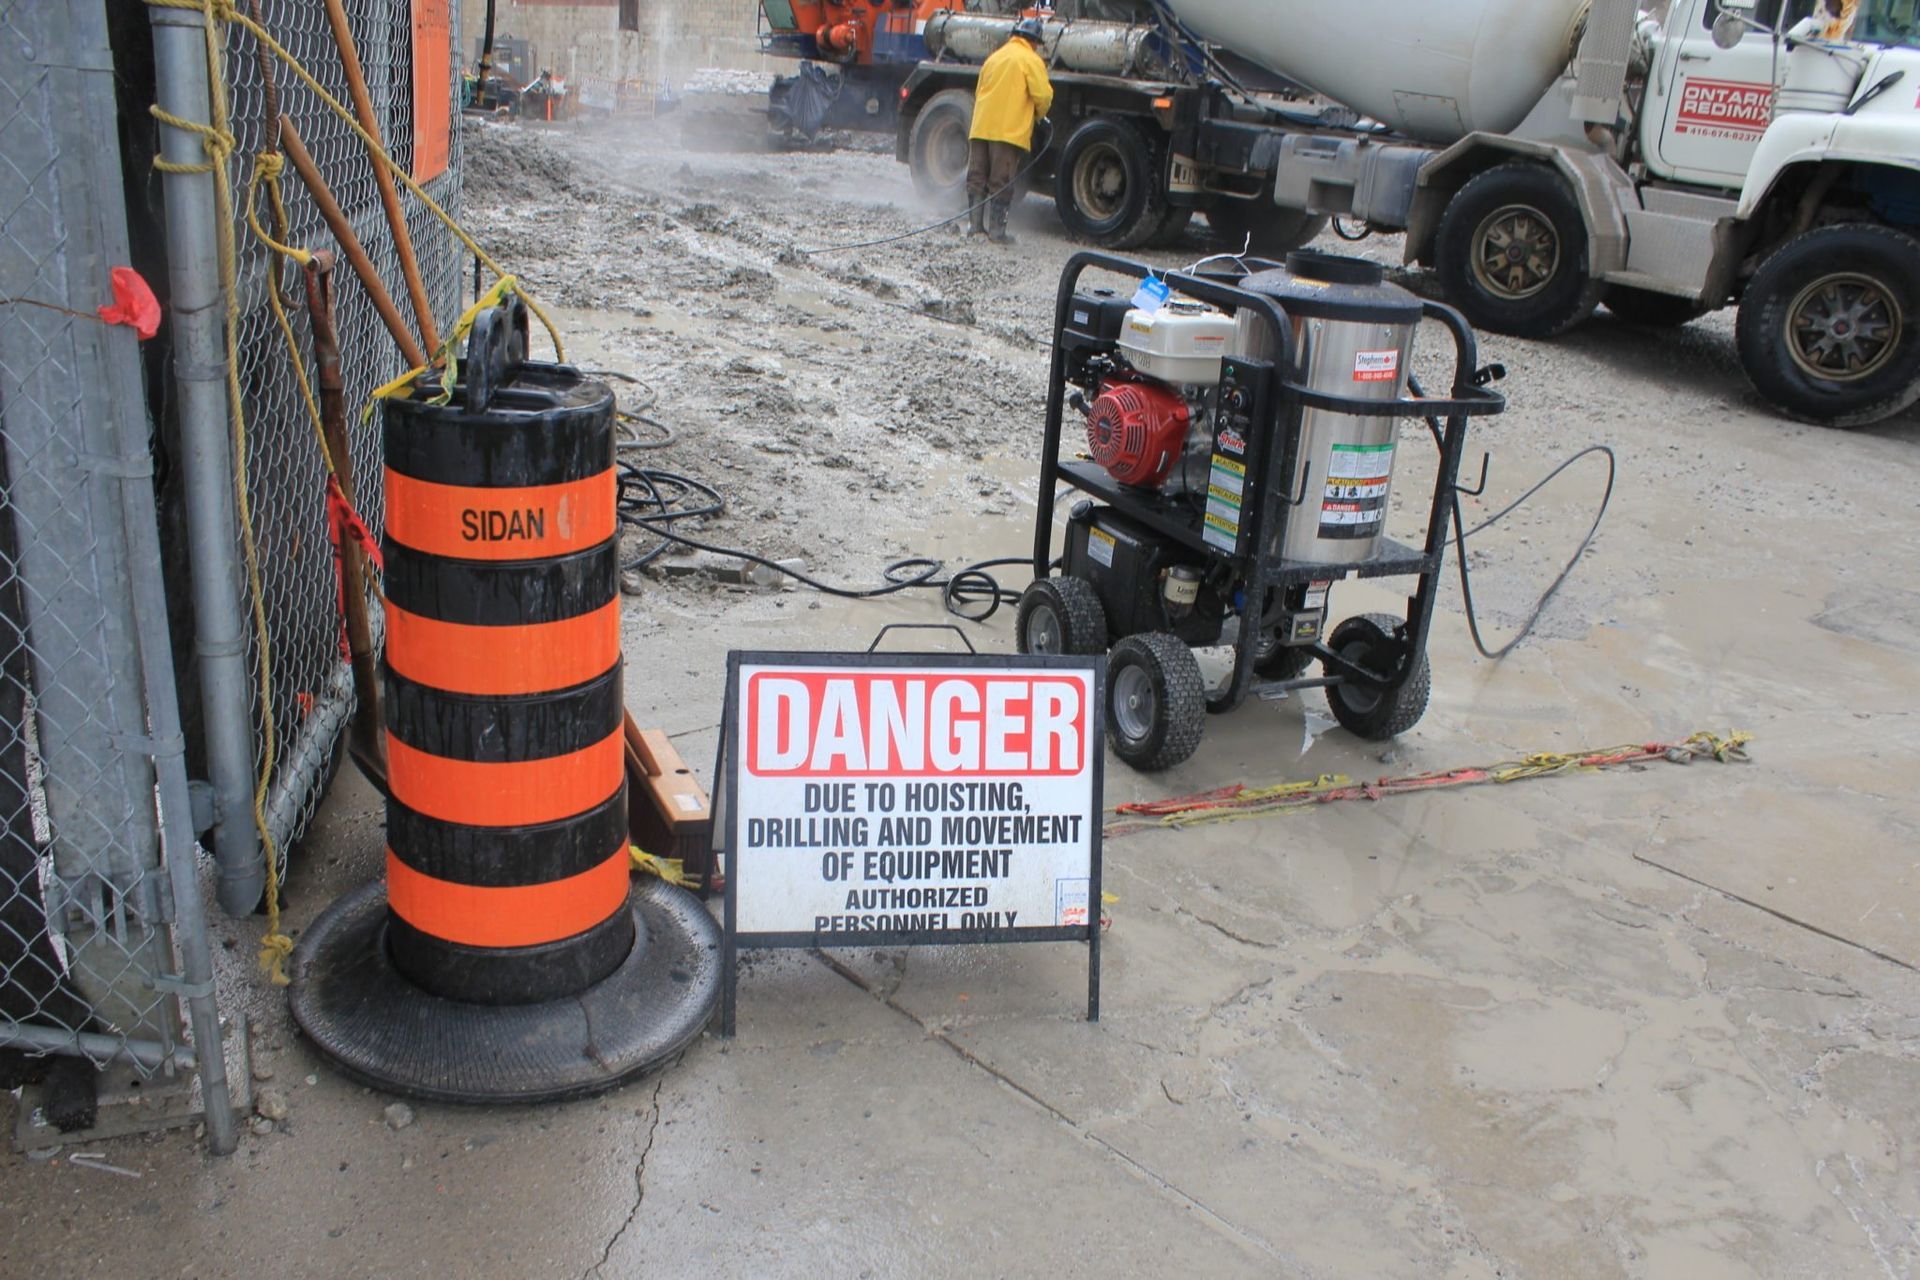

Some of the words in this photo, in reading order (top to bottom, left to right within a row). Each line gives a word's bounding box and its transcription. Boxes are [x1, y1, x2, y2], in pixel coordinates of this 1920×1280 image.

[1682, 99, 1771, 121] REDIMIX
[461, 507, 545, 542] SIDAN
[757, 678, 1080, 772] DANGER
[804, 783, 855, 813] DUE
[864, 783, 896, 812] TO
[906, 782, 1030, 815] HOISTING,
[748, 817, 868, 848] DRILLING
[877, 816, 931, 846] AND
[942, 815, 1082, 845] MOVEMENT
[822, 851, 854, 881] OF
[864, 850, 1013, 883] EQUIPMENT
[846, 886, 988, 910] AUTHORIZED
[815, 915, 950, 932] PERSONNEL
[961, 911, 1018, 930] ONLY
